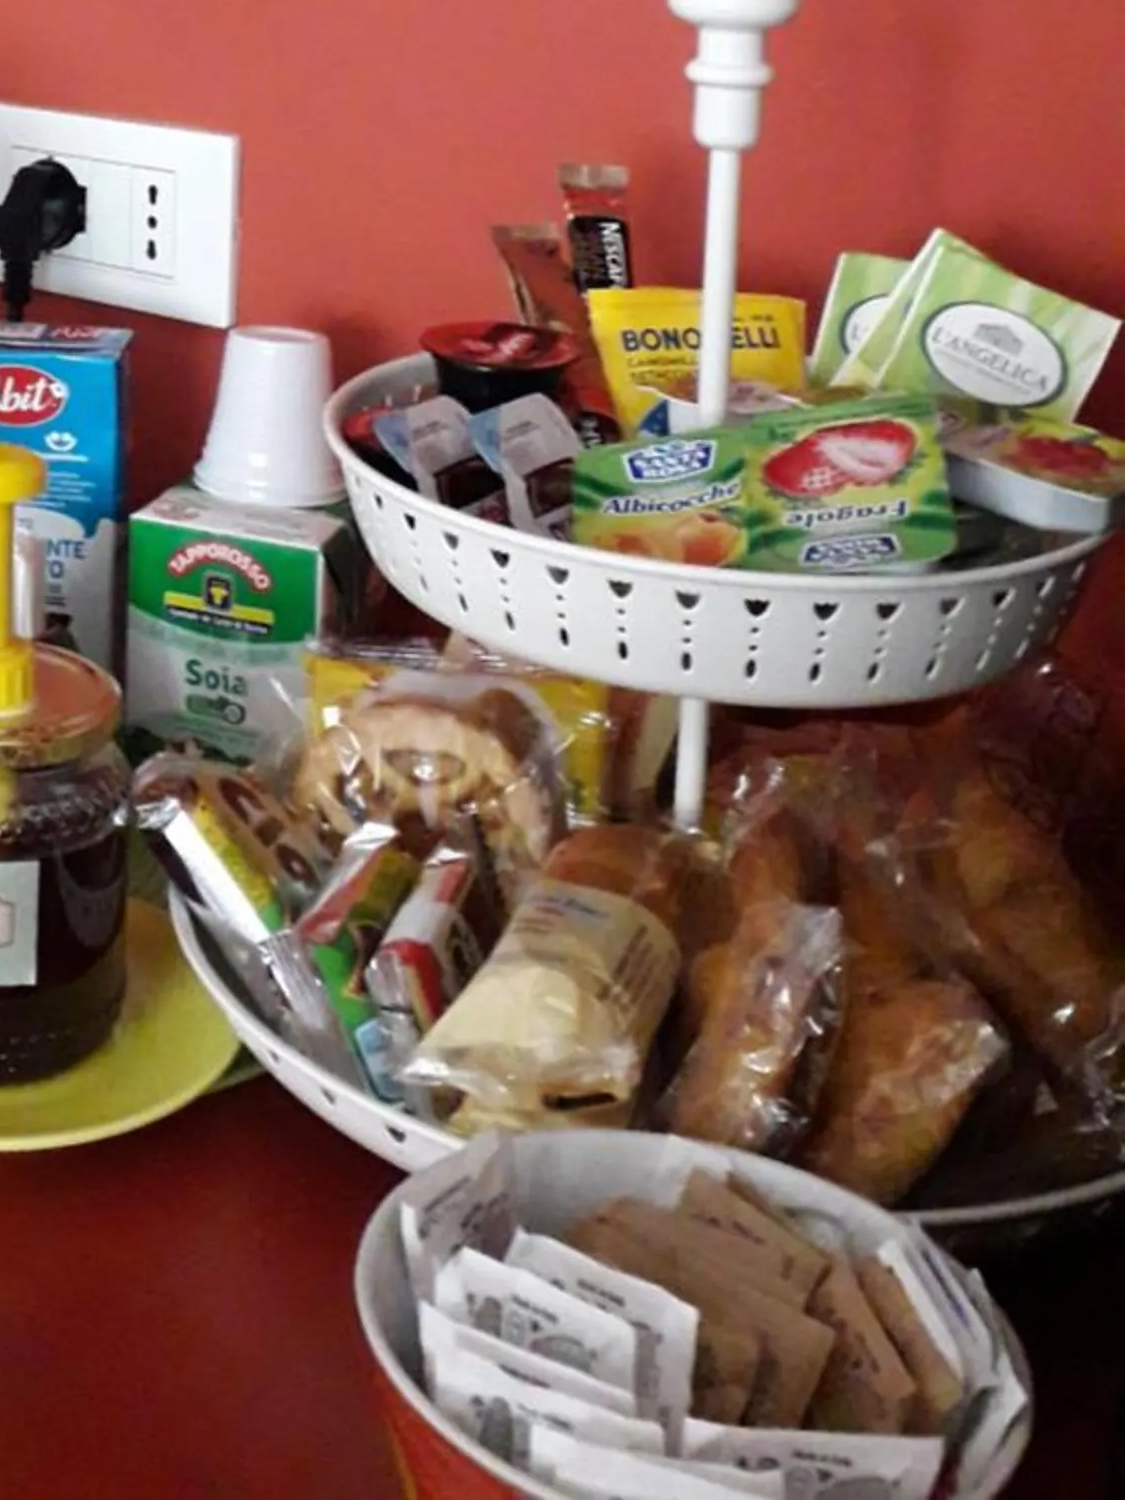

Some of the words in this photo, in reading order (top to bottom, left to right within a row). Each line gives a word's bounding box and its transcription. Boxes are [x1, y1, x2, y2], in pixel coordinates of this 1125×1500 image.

[622, 325, 779, 352] BONOELLI
[603, 482, 740, 515] Albicocche
[185, 658, 247, 696] Soia
